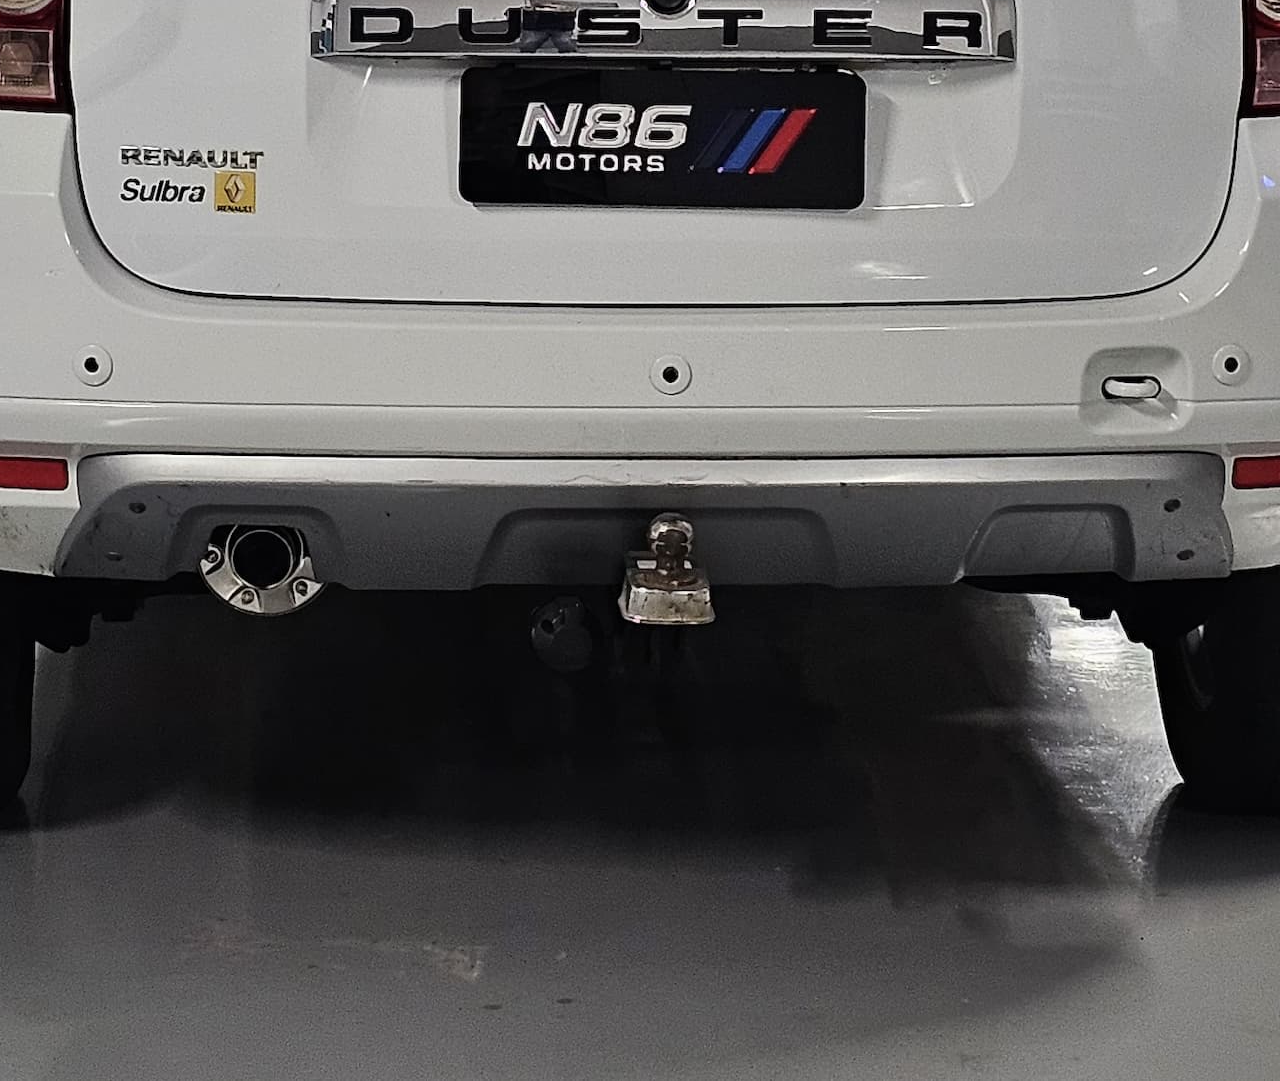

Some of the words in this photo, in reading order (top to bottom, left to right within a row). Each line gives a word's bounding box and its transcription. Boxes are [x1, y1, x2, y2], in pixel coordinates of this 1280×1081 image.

[349, 6, 984, 47] DUSTER
[517, 102, 693, 149] N86
[120, 145, 265, 170] RENAULT
[527, 153, 665, 174] MOTORS
[120, 177, 207, 203] Sulbra
